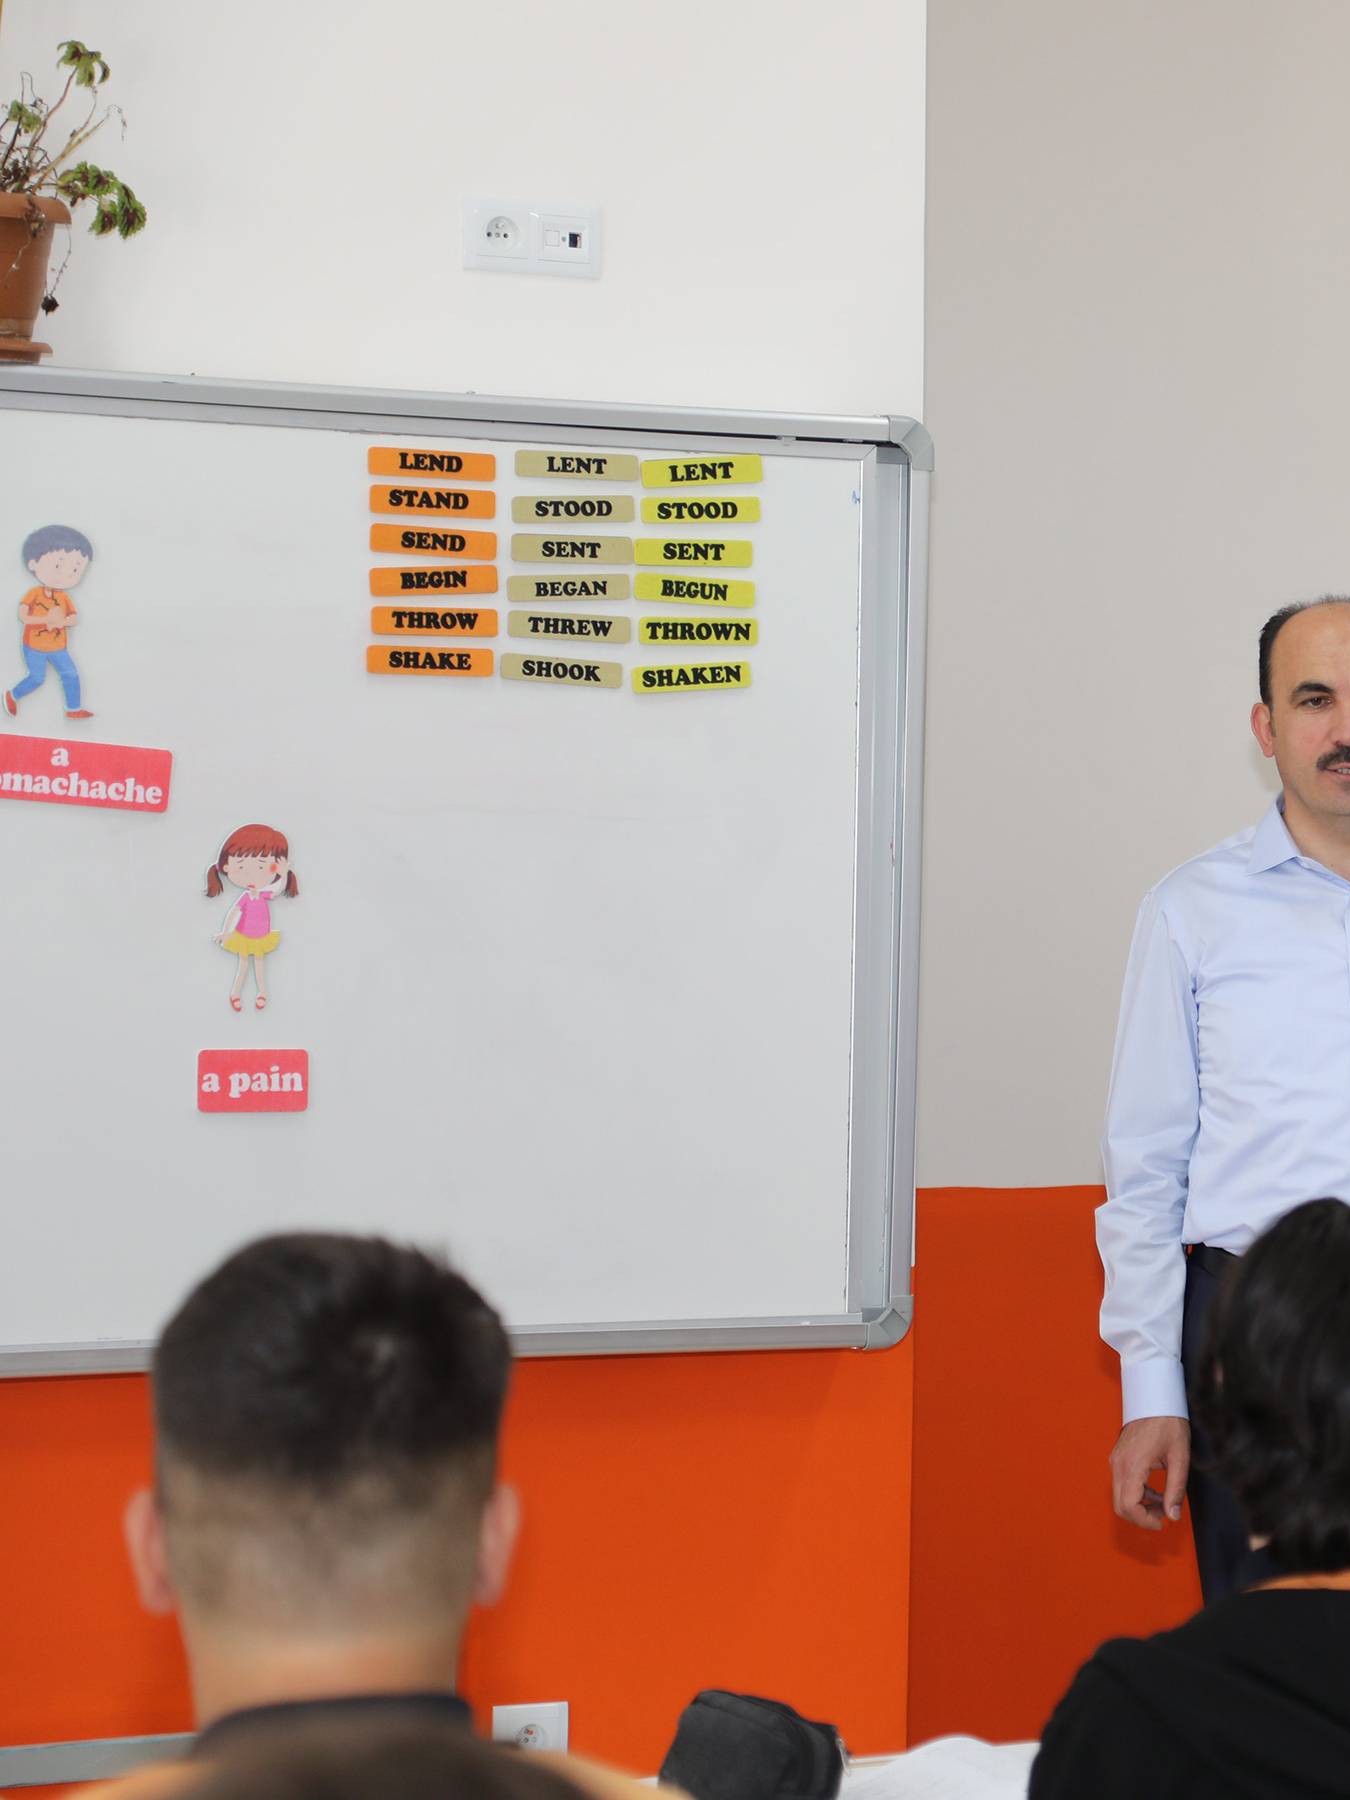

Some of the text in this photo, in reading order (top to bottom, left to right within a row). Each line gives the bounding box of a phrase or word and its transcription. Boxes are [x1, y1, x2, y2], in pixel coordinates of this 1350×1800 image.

[399, 452, 463, 473] LEND
[546, 456, 608, 475] LENT
[668, 461, 734, 482] LENT
[388, 489, 469, 510] STAND
[535, 500, 613, 517] STOOD
[657, 501, 738, 520] STOOD
[401, 531, 466, 552] SEND
[541, 540, 602, 559] SENT
[663, 542, 726, 561] SENT
[400, 570, 467, 590] BEGIN
[534, 580, 608, 597] BEGAN
[660, 579, 729, 601] BEGUN
[391, 611, 479, 630] THROW
[527, 616, 613, 637] THREW
[645, 622, 751, 641] THROWN
[388, 650, 472, 671] SHAKE
[521, 659, 601, 682] SHOOK
[642, 664, 741, 688] SHAKEN
[50, 747, 70, 767] a
[0, 771, 163, 805] machache
[201, 1066, 304, 1098] a pain
